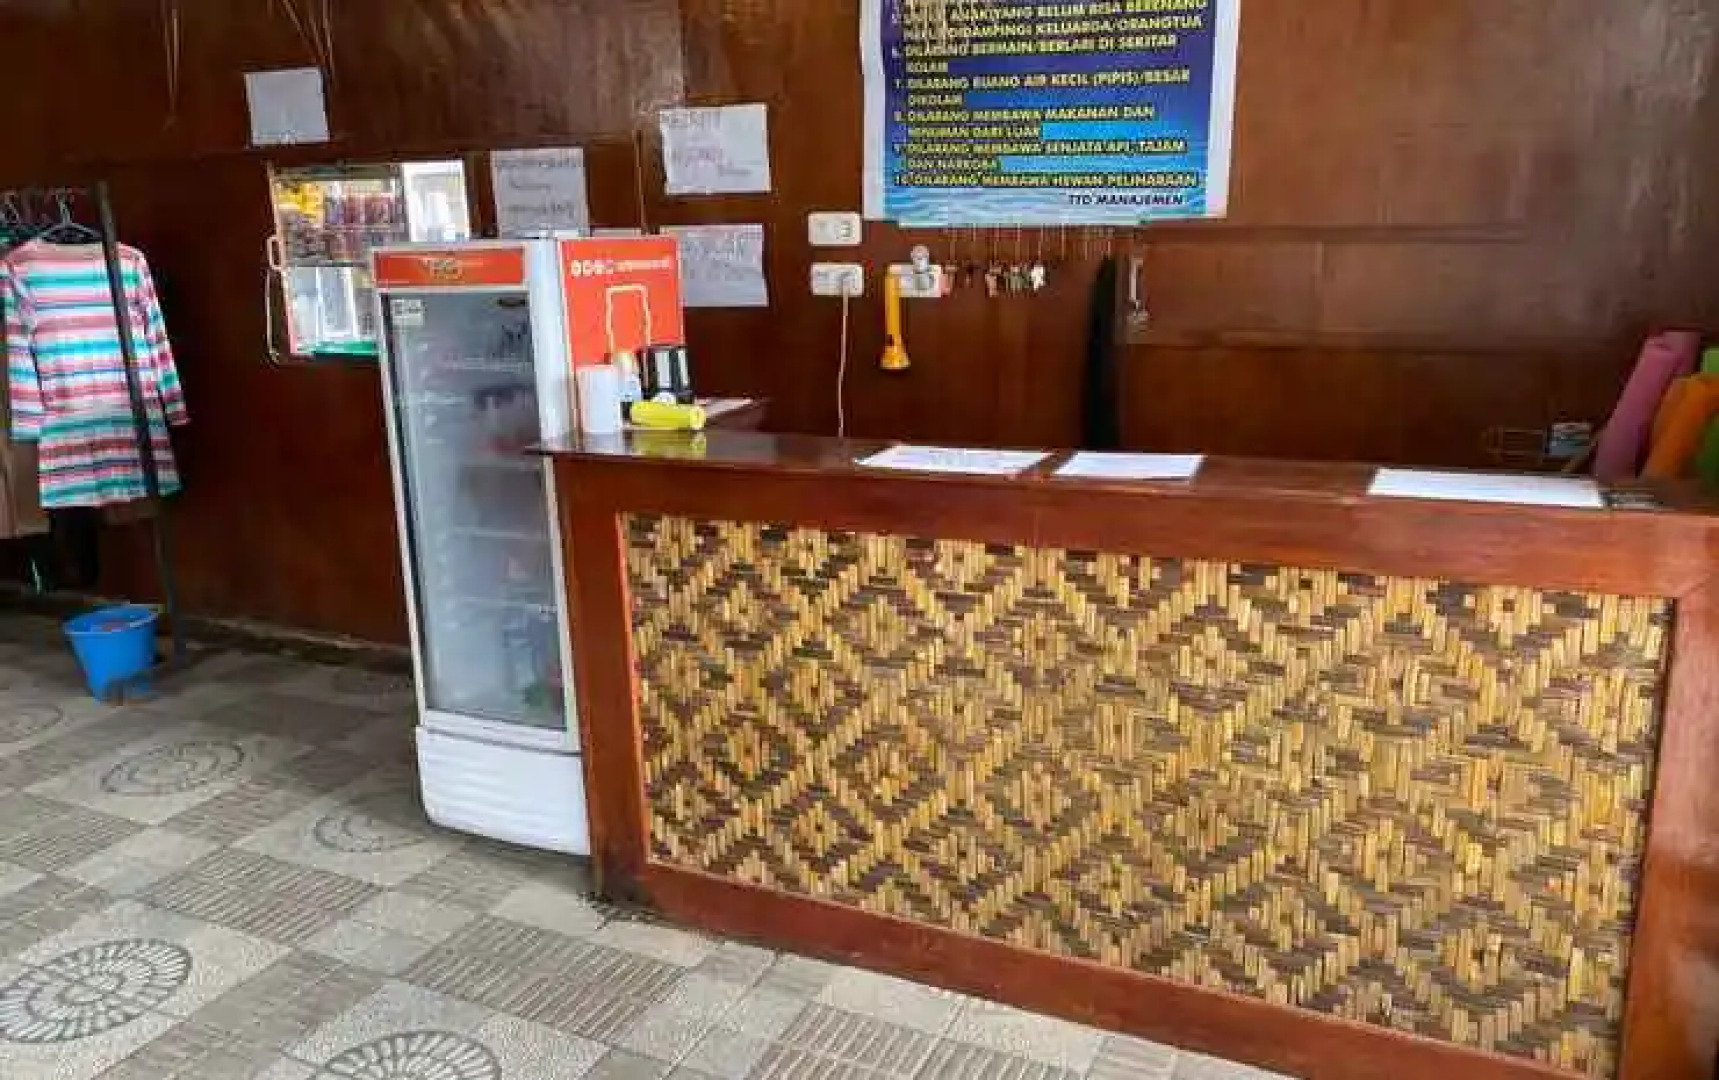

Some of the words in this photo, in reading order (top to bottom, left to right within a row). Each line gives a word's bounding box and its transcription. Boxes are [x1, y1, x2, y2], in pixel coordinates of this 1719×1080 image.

[1037, 4, 1084, 18] BELUM
[1089, 2, 1122, 15] BISA
[1125, 0, 1208, 13] BERENANG
[1099, 38, 1115, 50] DI
[1117, 34, 1177, 49] SEKITAR
[906, 61, 949, 73] KOLAM
[907, 76, 970, 90] DILARANG
[973, 75, 1019, 88] BUANG
[1023, 74, 1048, 87] AIR
[1051, 72, 1090, 86] KECIL
[907, 109, 971, 122] DILARANG
[973, 108, 1041, 121] MEMBAWA
[1045, 106, 1120, 120] MAKANAN
[1123, 106, 1154, 119] DAN
[908, 126, 971, 138] MINUMAN
[974, 126, 1003, 138] DARI
[1006, 125, 1041, 138] LUAR
[907, 142, 971, 154] DILARANG
[973, 142, 1041, 154] MEMBAWA
[1139, 140, 1187, 152] TAJAM
[908, 158, 936, 170] DAN
[913, 173, 979, 186] DILARANG
[982, 174, 1049, 186] MEMBAWA
[1053, 173, 1104, 186] HEWAN
[1107, 172, 1198, 186] PELIHARAAN
[1068, 194, 1093, 205] TTD
[1096, 194, 1184, 206] MANAJEMEN
